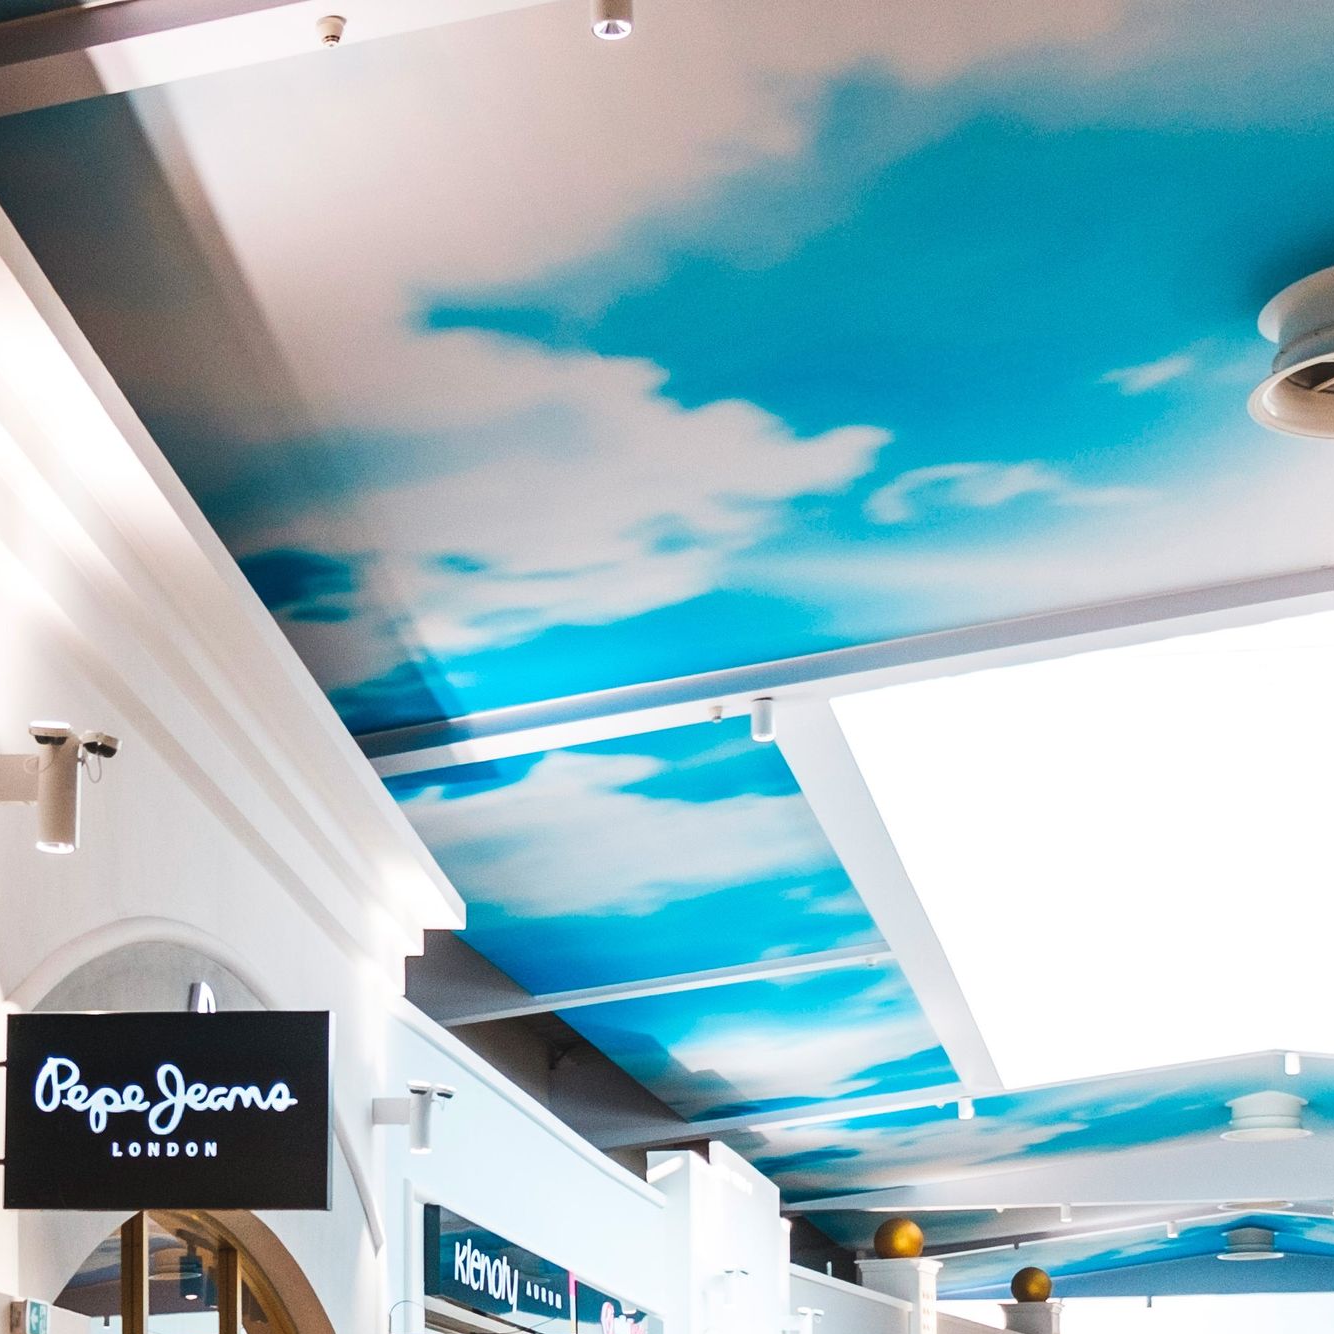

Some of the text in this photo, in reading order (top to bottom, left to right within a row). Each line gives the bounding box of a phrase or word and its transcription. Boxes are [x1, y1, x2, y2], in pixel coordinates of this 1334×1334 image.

[35, 1057, 299, 1135] Pepe Jeans
[111, 1141, 219, 1158] LONDON
[525, 1281, 562, 1309] AURUM
